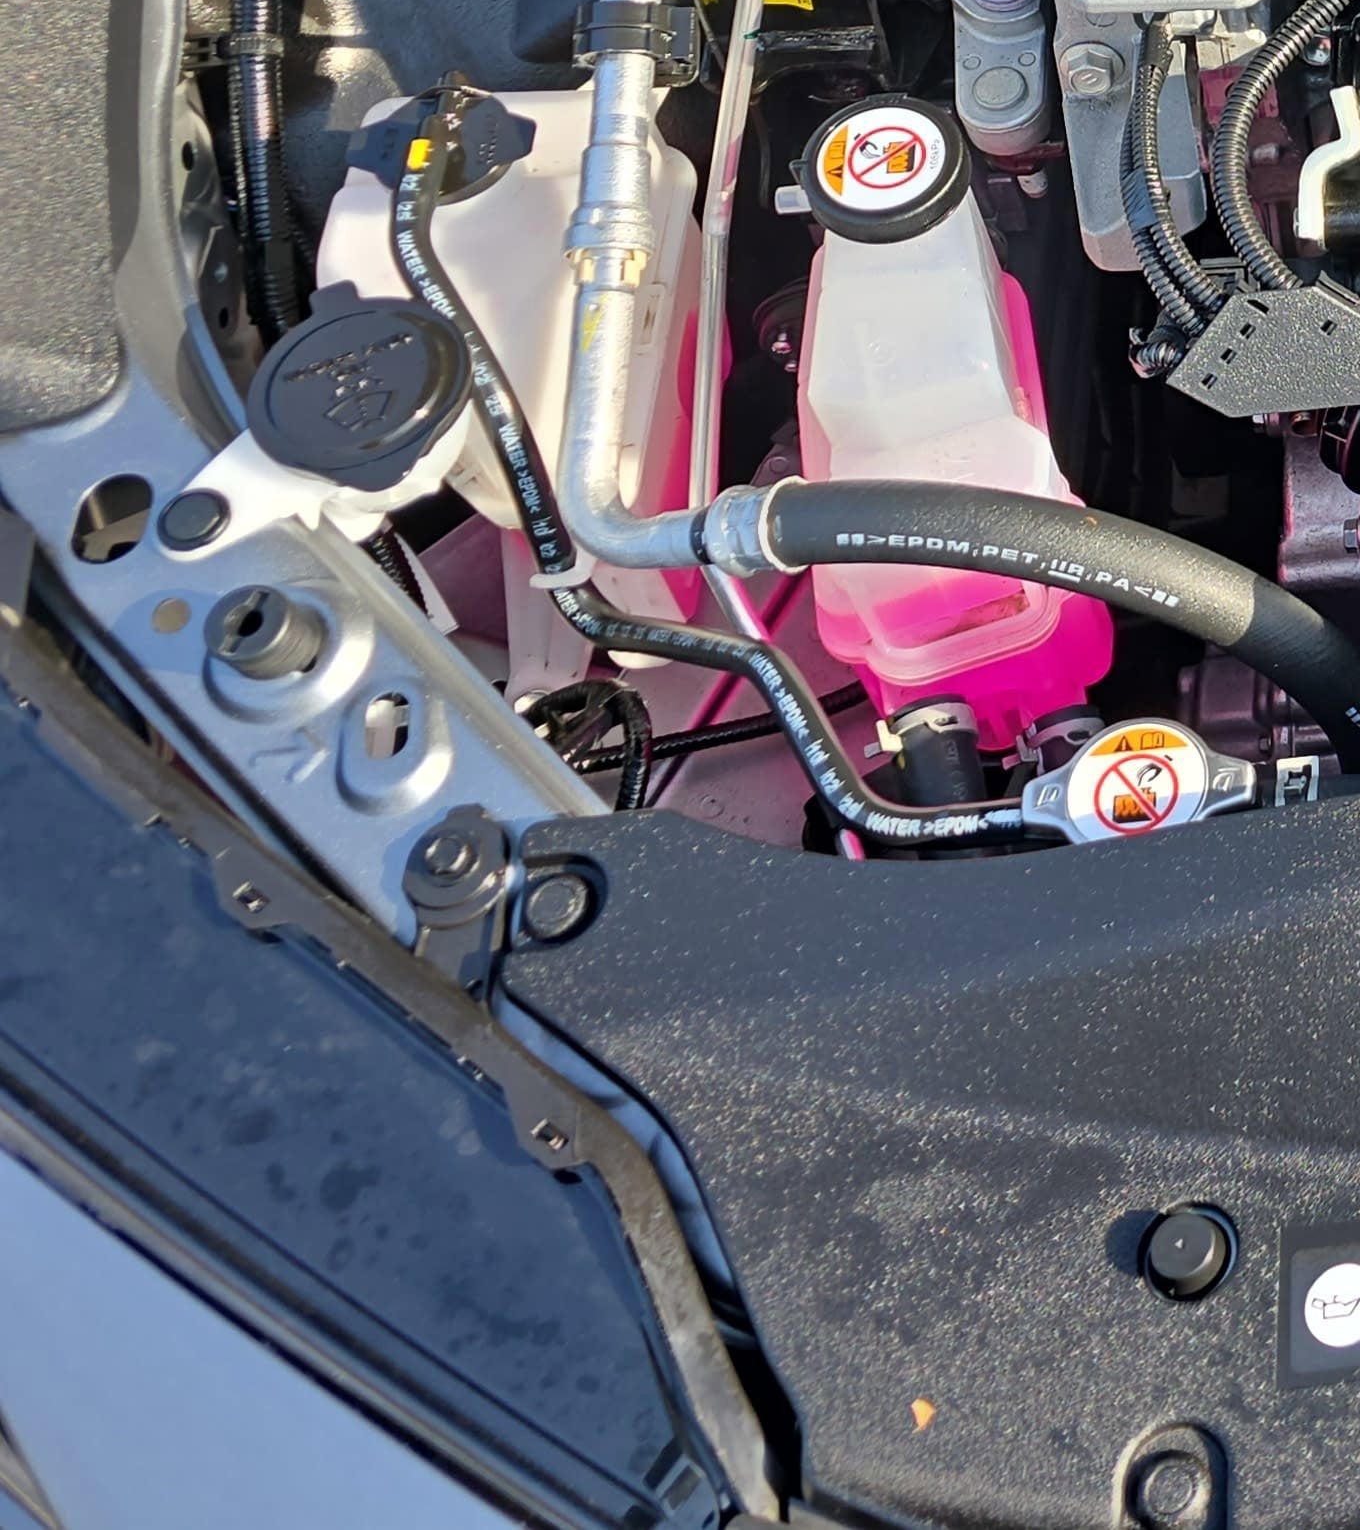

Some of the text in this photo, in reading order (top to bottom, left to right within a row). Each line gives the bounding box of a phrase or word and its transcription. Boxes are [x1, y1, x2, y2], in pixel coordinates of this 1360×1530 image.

[397, 230, 427, 278] WATER
[499, 421, 525, 467] WATER
[749, 653, 782, 691] WATER
[775, 688, 809, 739] >EPDM<
[866, 812, 921, 836] WATER
